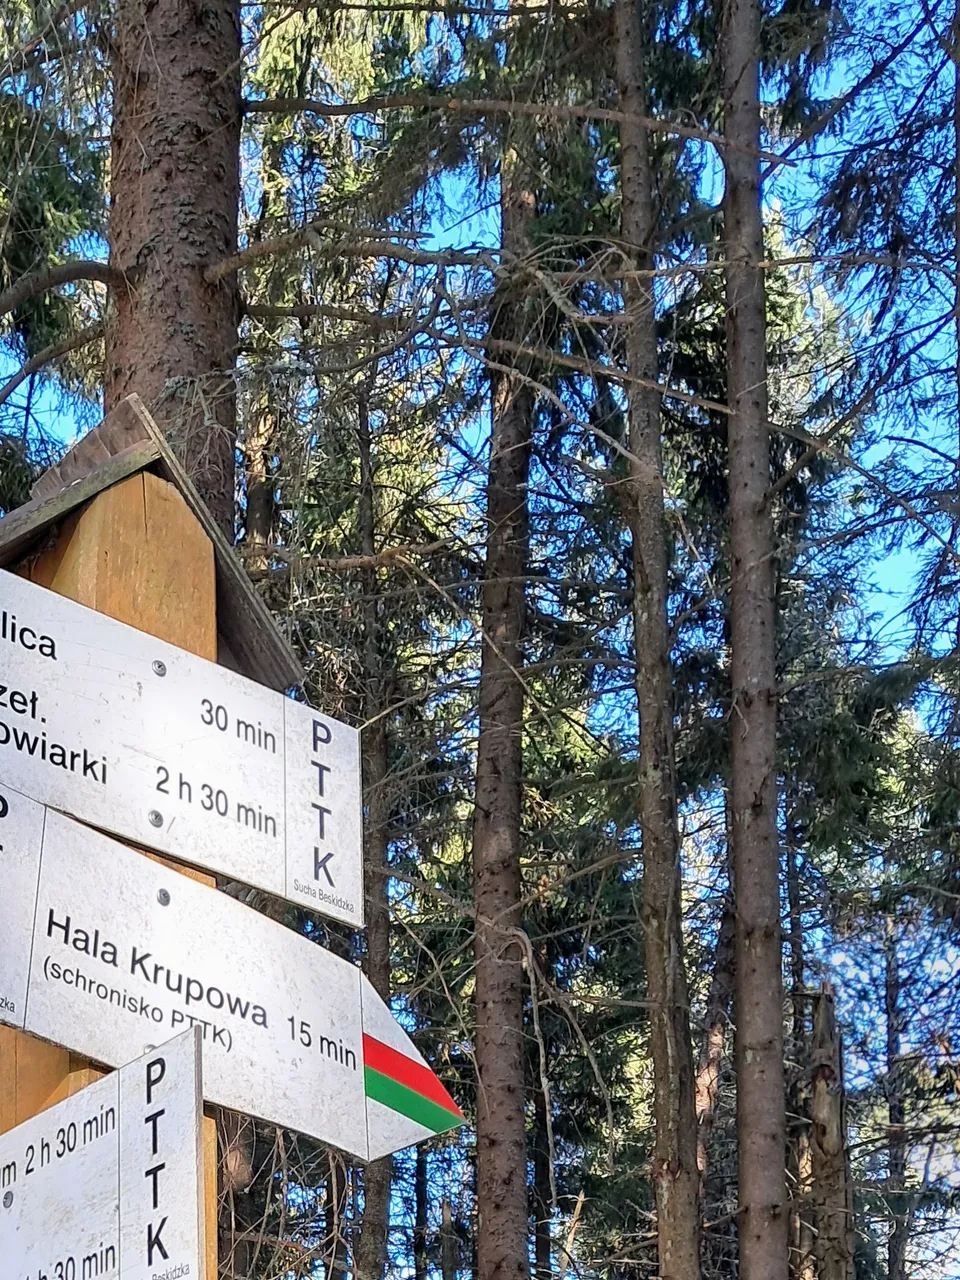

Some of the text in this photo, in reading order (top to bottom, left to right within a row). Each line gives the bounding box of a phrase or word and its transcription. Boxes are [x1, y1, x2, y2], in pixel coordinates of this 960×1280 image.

[201, 699, 276, 753] 30 min
[156, 766, 276, 837] 2 h 30 min
[311, 718, 335, 888] PTTK
[294, 879, 355, 913] Sucha Beskidzka
[43, 955, 164, 1023] (schronisko
[46, 908, 357, 1071] Hala Krupowa 15 min
[25, 1144, 35, 1175] 2
[40, 1137, 50, 1168] h
[56, 1121, 76, 1158] 30
[83, 1104, 115, 1146] min
[144, 1057, 170, 1267] PTTK
